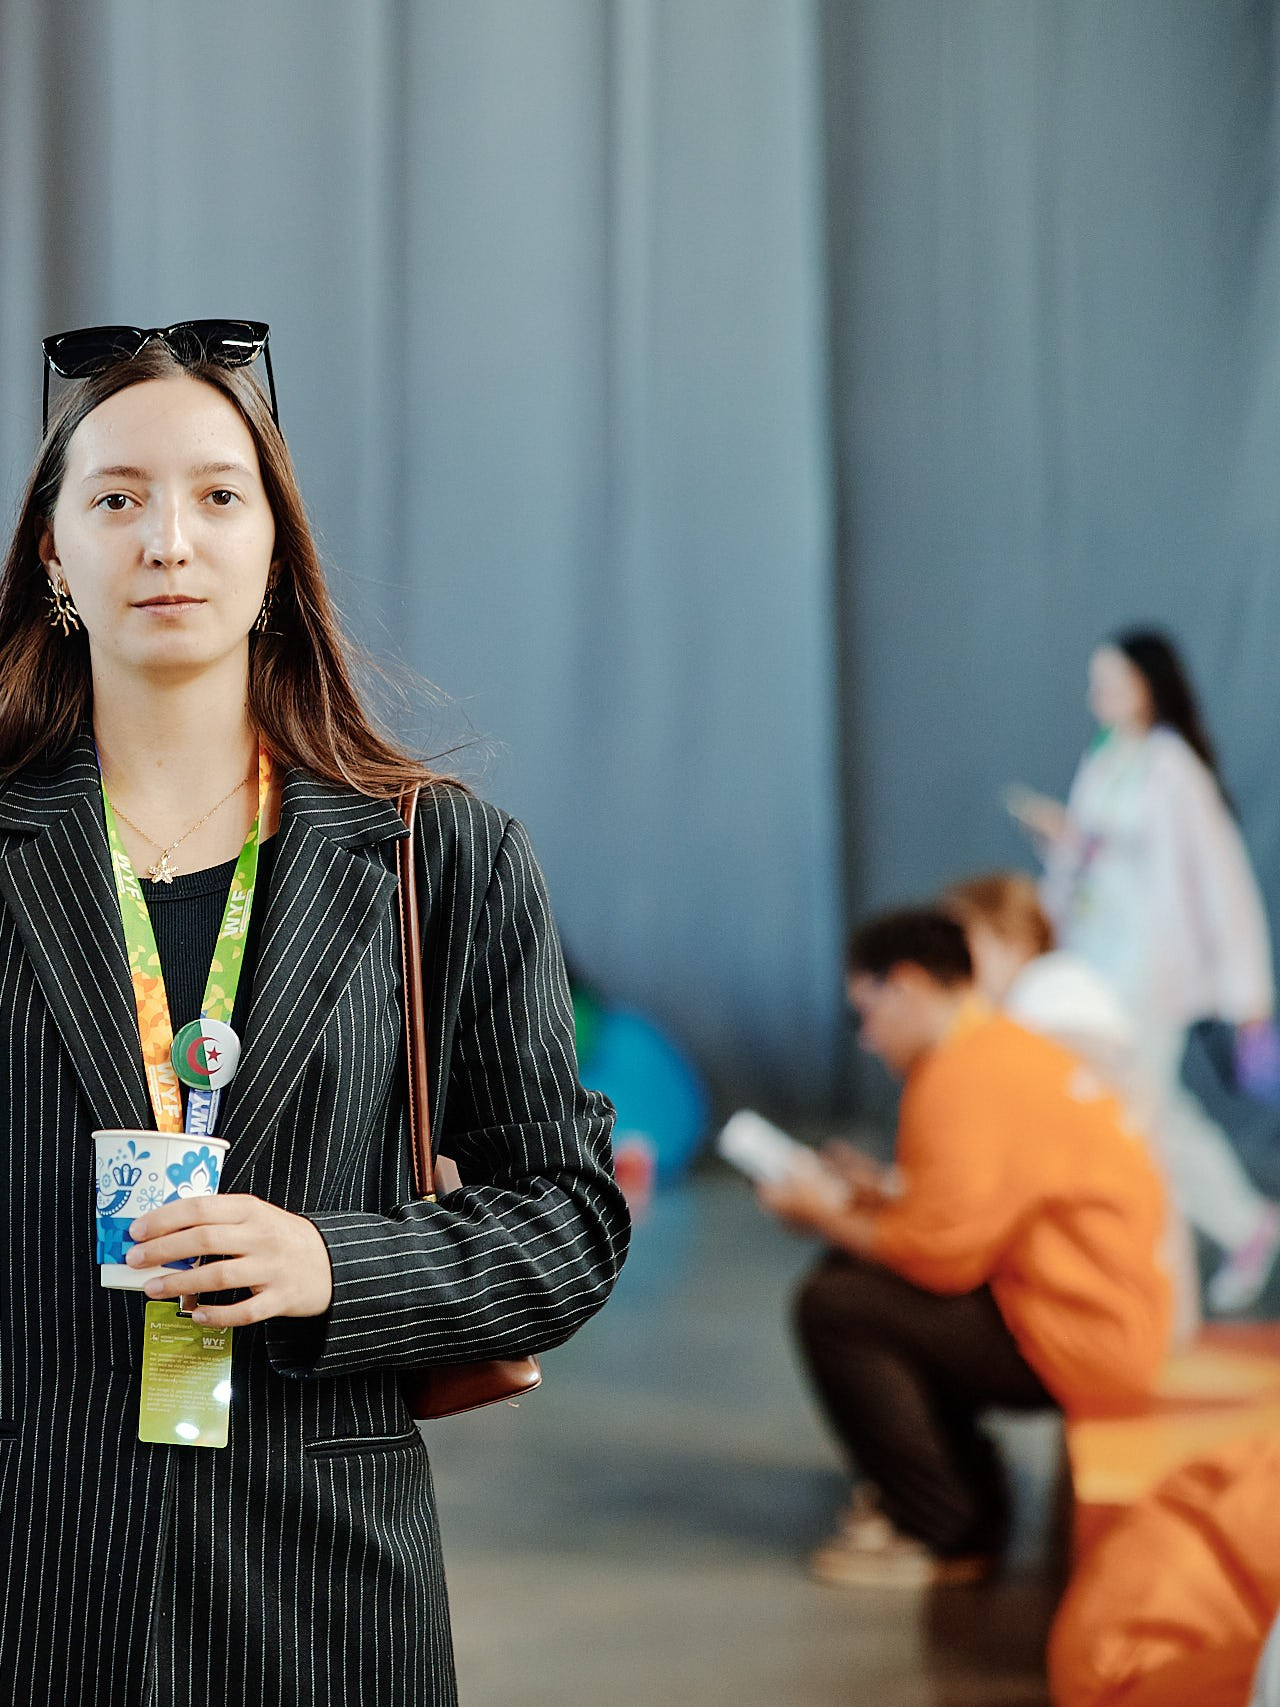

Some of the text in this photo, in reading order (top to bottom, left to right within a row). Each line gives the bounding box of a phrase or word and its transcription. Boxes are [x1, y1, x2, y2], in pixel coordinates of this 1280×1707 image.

[117, 853, 142, 900] WYF
[223, 890, 246, 937] WYF
[158, 1062, 180, 1118] WYF
[189, 1089, 212, 1135] WY
[202, 1336, 225, 1347] WYF
